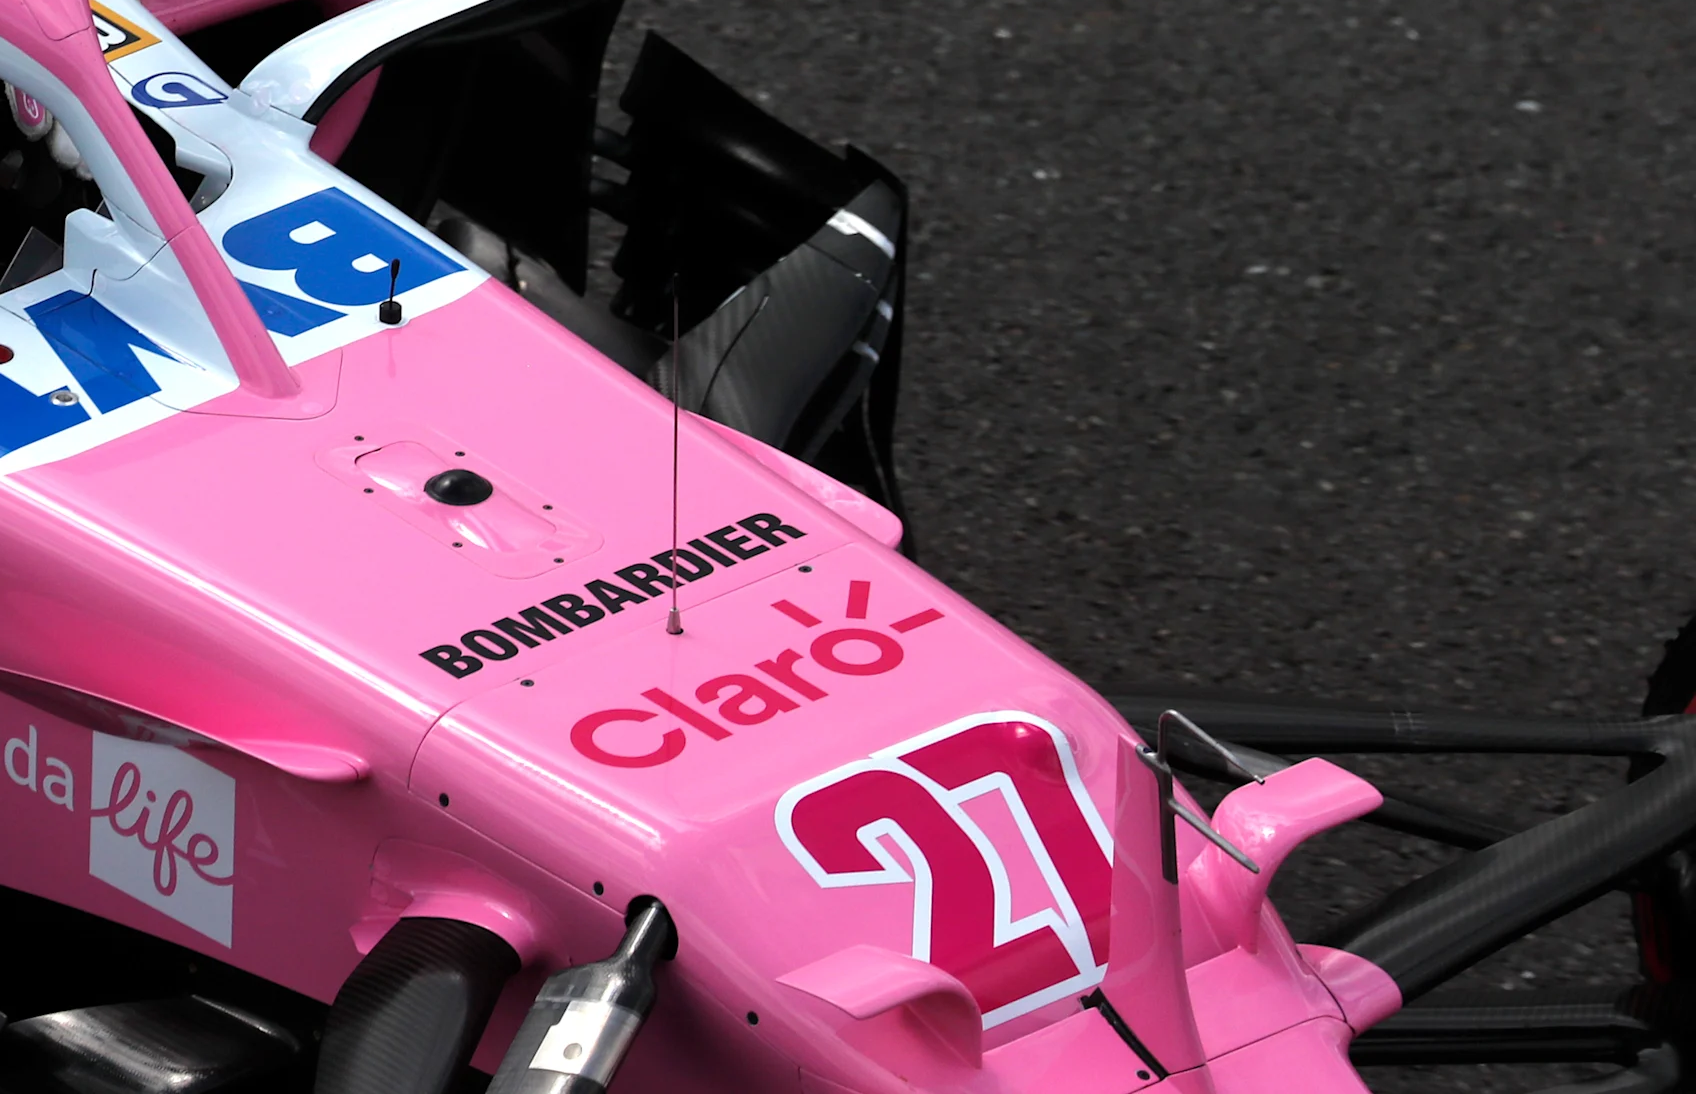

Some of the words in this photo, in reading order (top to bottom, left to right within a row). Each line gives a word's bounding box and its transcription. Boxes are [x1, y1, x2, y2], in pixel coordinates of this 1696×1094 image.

[418, 512, 808, 679] BOMBARDIER
[570, 580, 945, 768] Claro
[91, 761, 234, 897] life
[775, 709, 1116, 1031] 27
